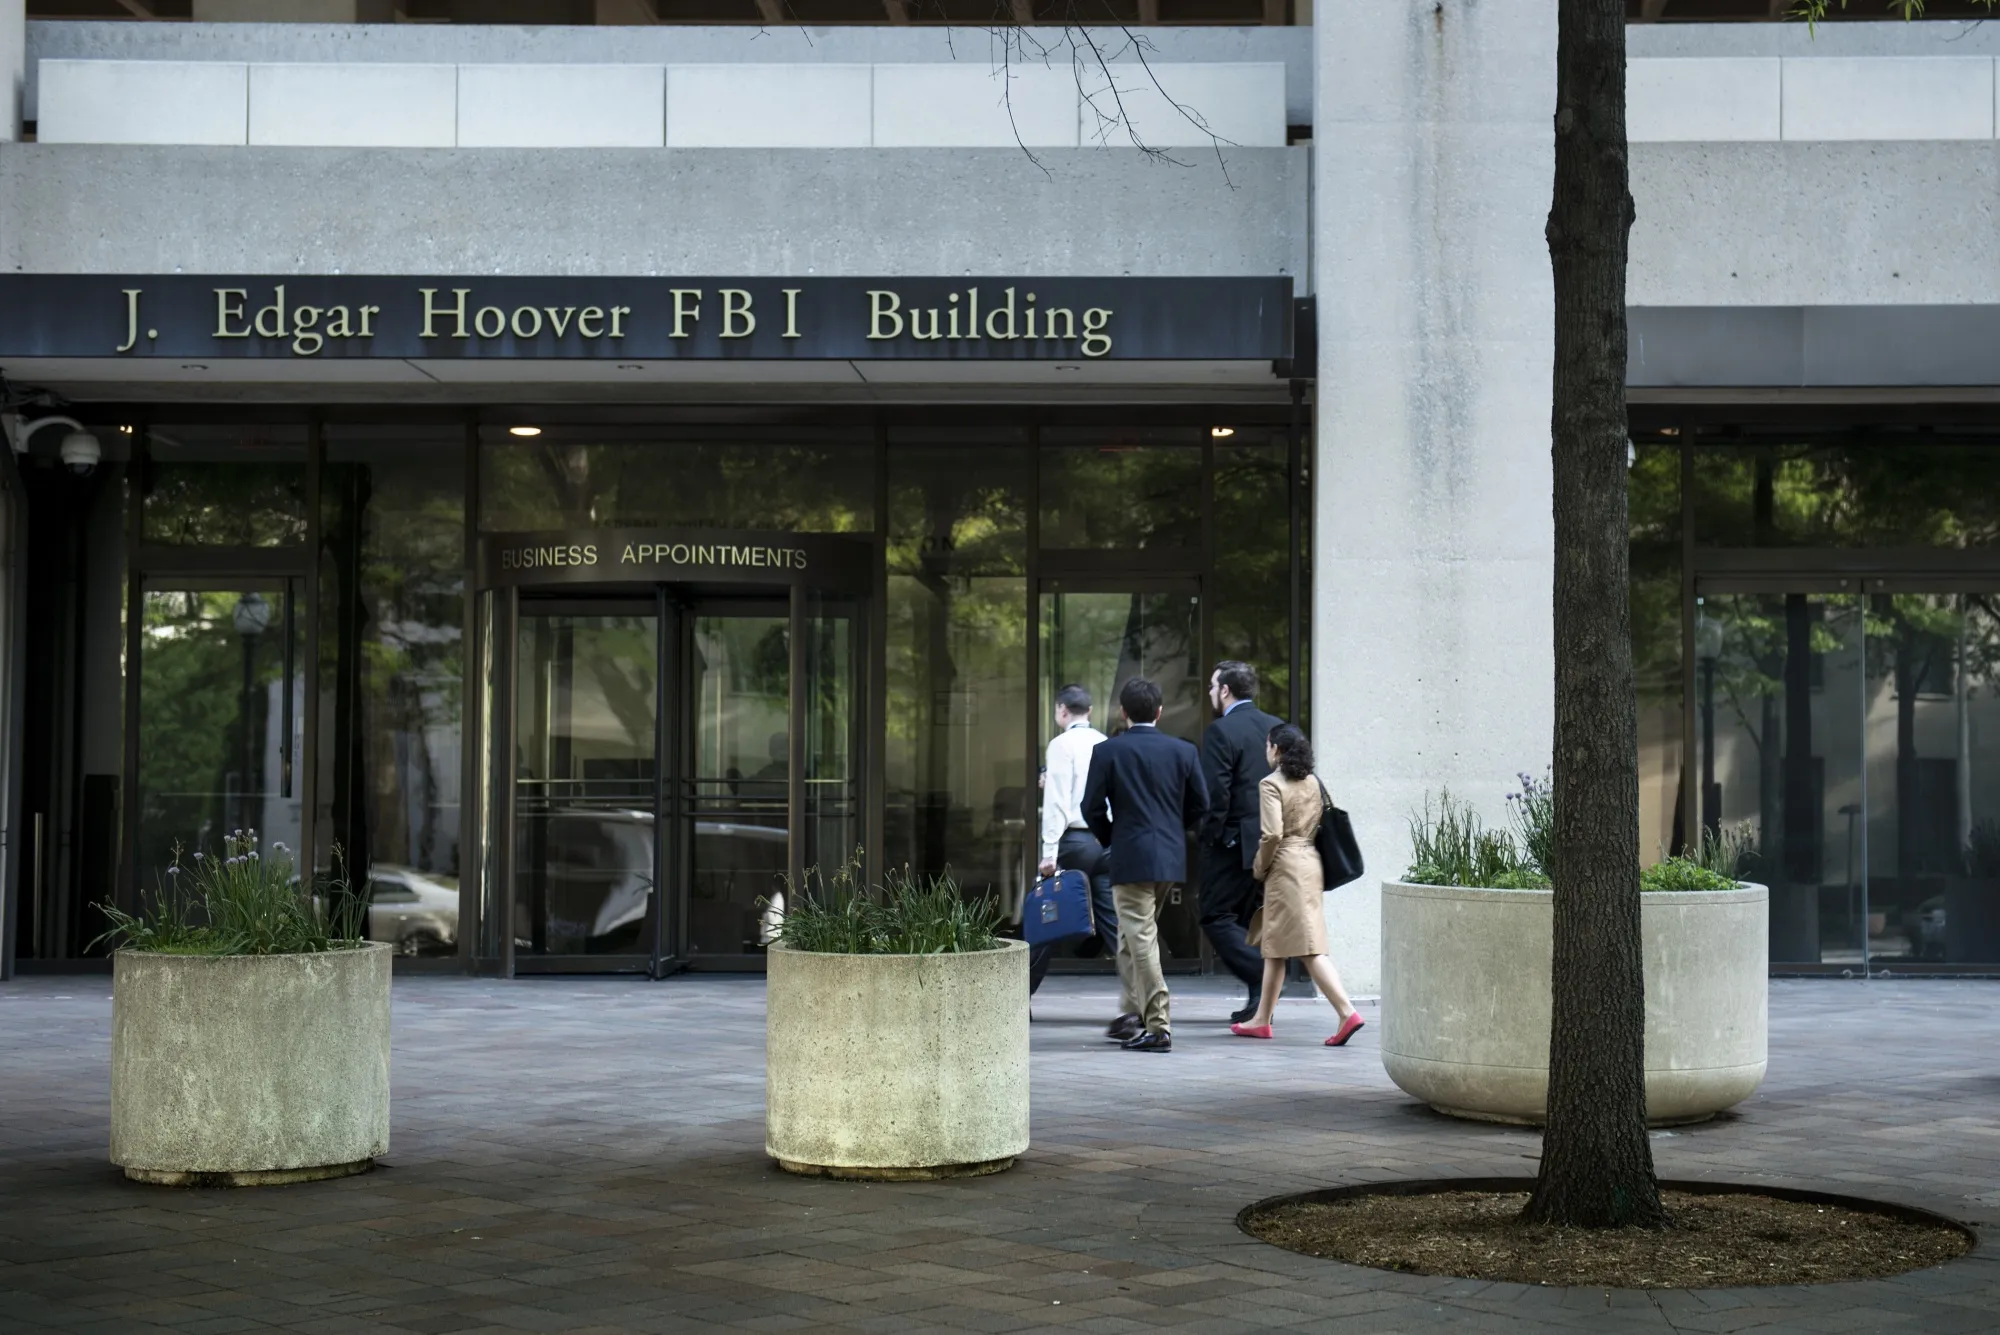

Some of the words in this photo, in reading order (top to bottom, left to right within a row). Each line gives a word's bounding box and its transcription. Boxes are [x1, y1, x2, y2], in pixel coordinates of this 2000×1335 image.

[117, 289, 158, 352] J.
[212, 285, 380, 355] Edgar
[419, 288, 631, 338] Hoover
[866, 286, 1114, 357] Building
[502, 545, 598, 569] BUSINESS
[620, 544, 807, 569] APPOINTMENTS
